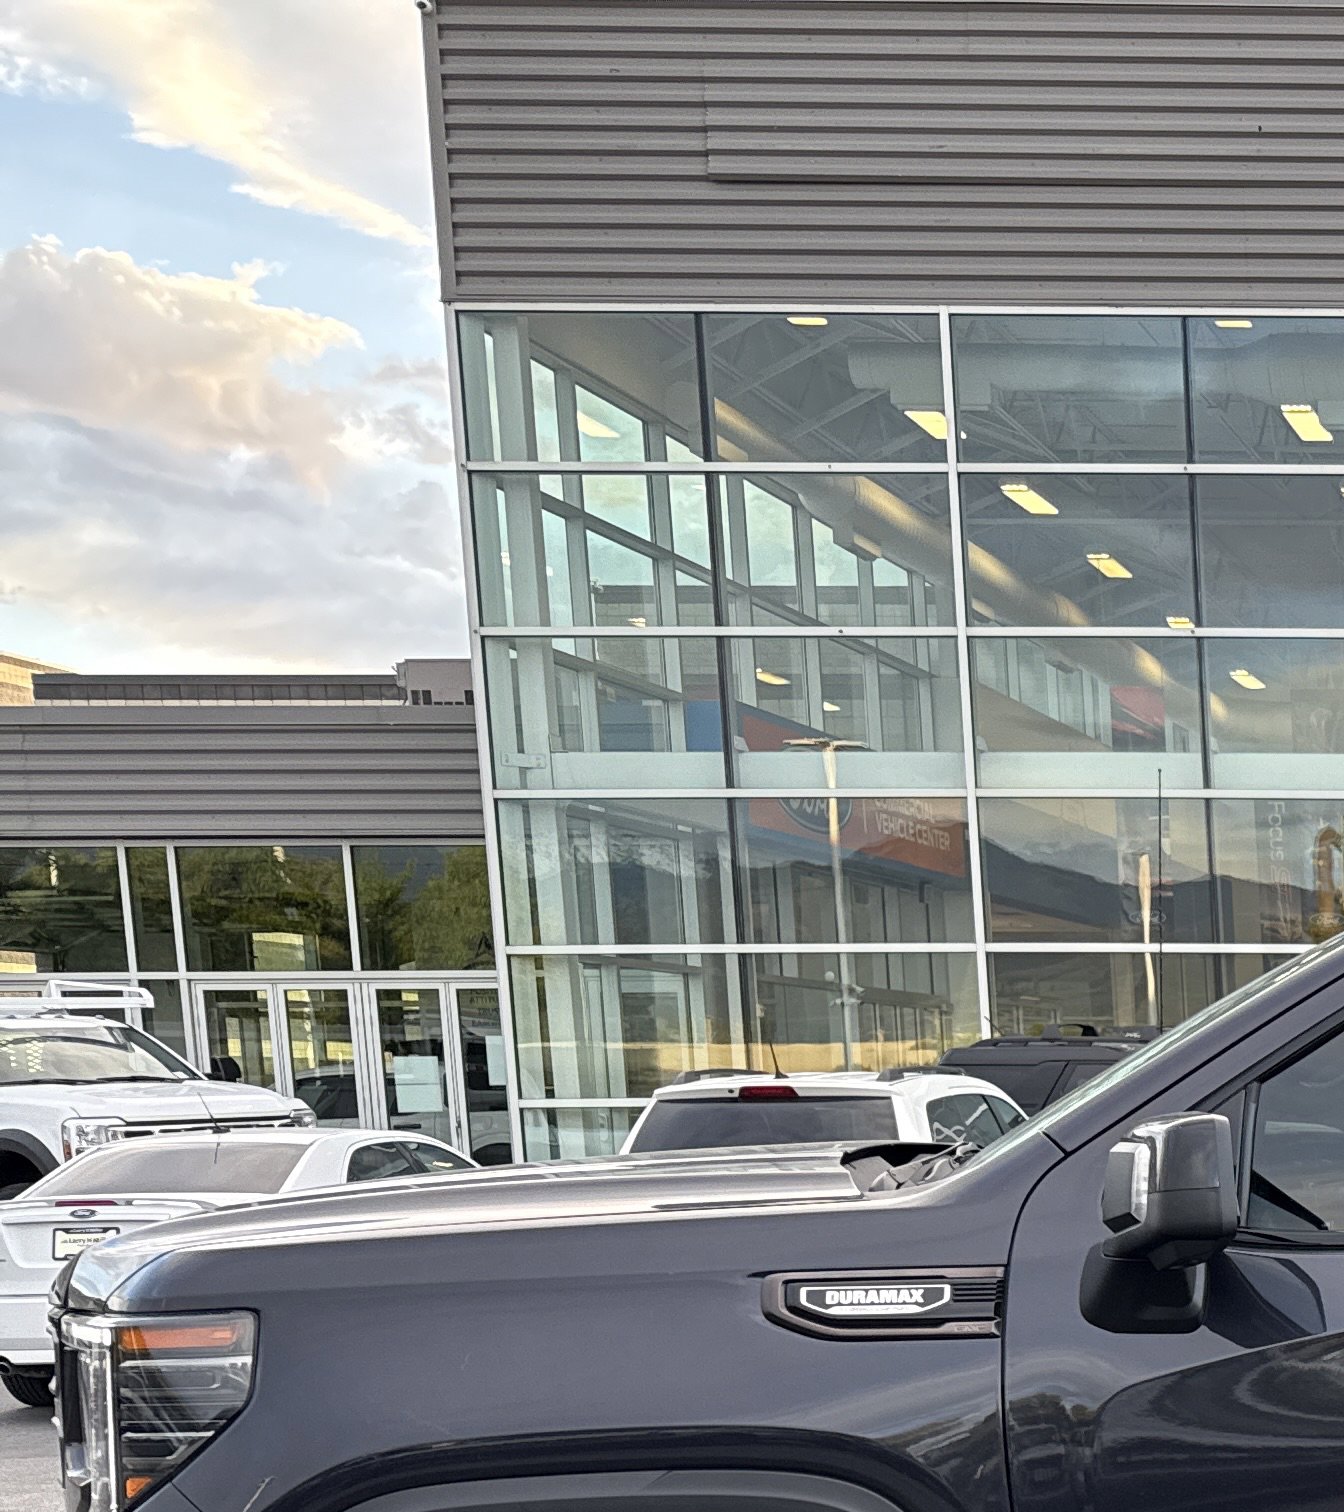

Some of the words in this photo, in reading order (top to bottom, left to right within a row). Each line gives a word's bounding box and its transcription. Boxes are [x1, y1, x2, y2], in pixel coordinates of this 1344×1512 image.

[875, 812, 915, 840] VEHICLE
[915, 825, 950, 850] CENTER
[825, 1288, 925, 1305] DURAMAX
